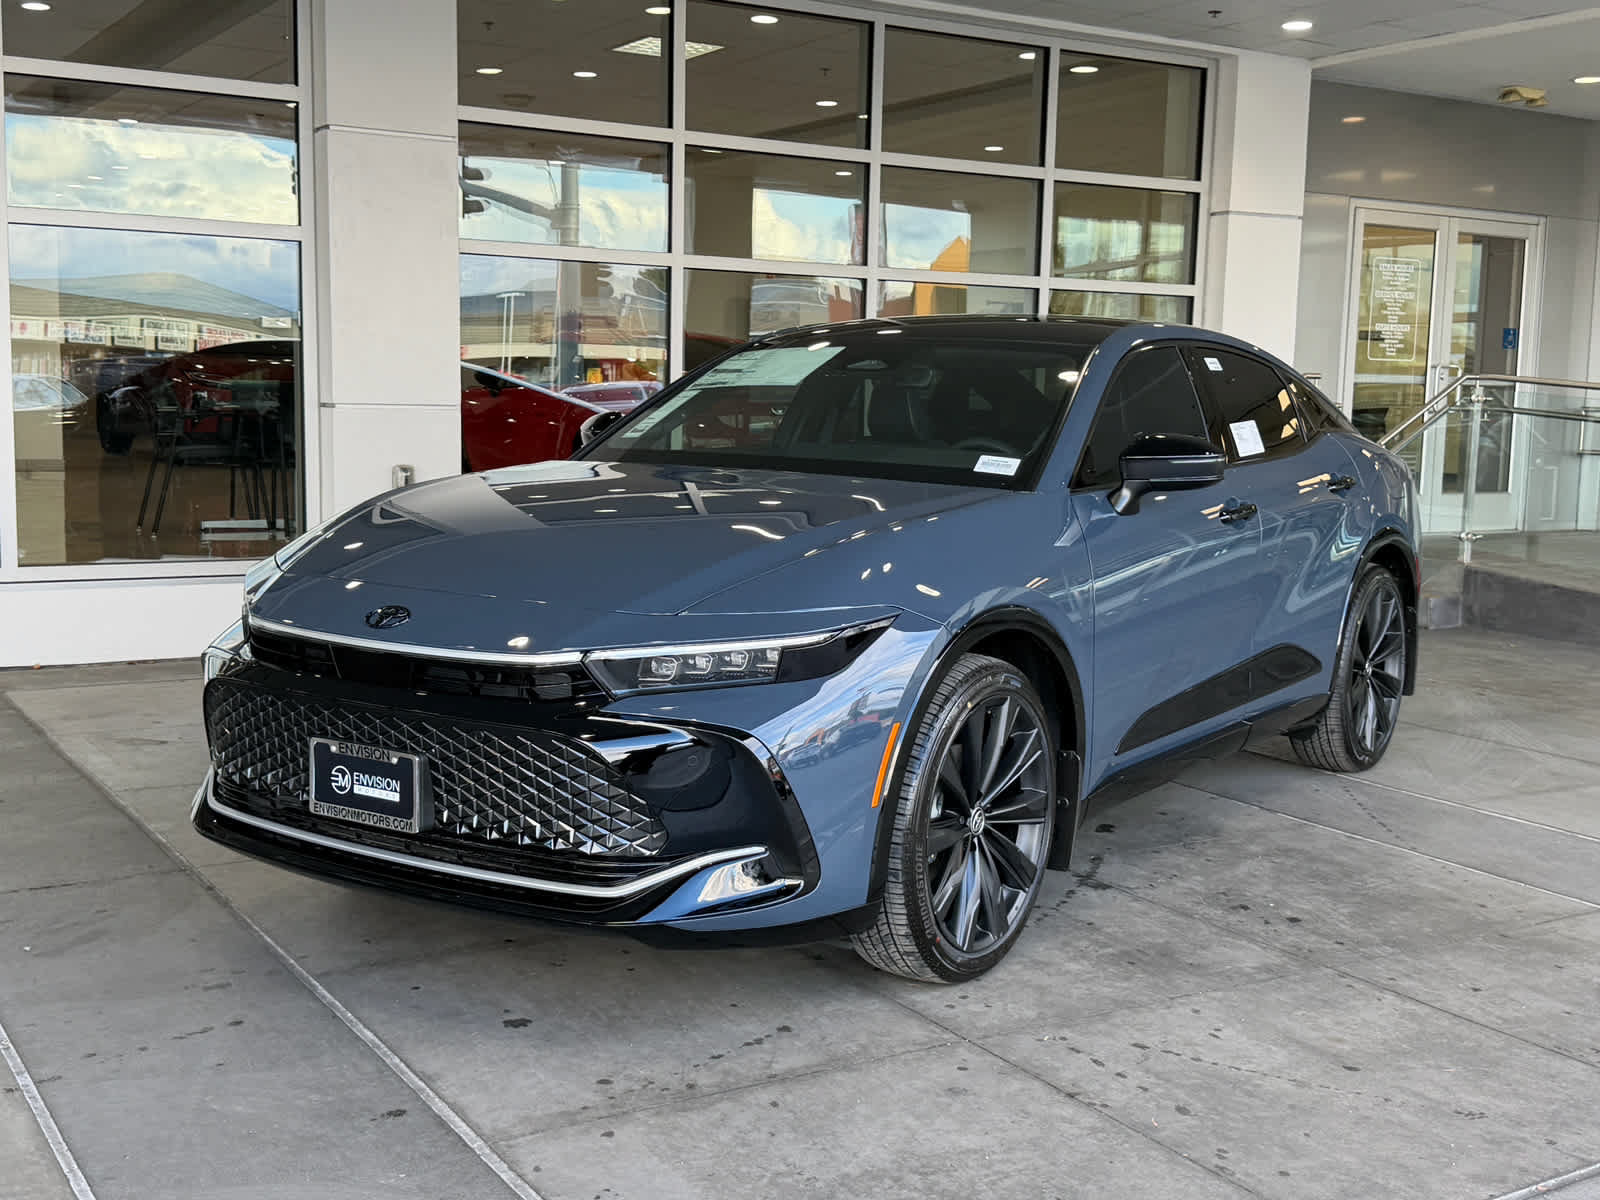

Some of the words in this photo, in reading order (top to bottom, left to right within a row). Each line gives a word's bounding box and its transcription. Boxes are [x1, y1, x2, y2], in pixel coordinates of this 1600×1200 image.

[339, 743, 390, 761] ENVISION
[353, 772, 400, 793] ENVISION
[313, 802, 413, 831] ENVISIONMOTORS.COM
